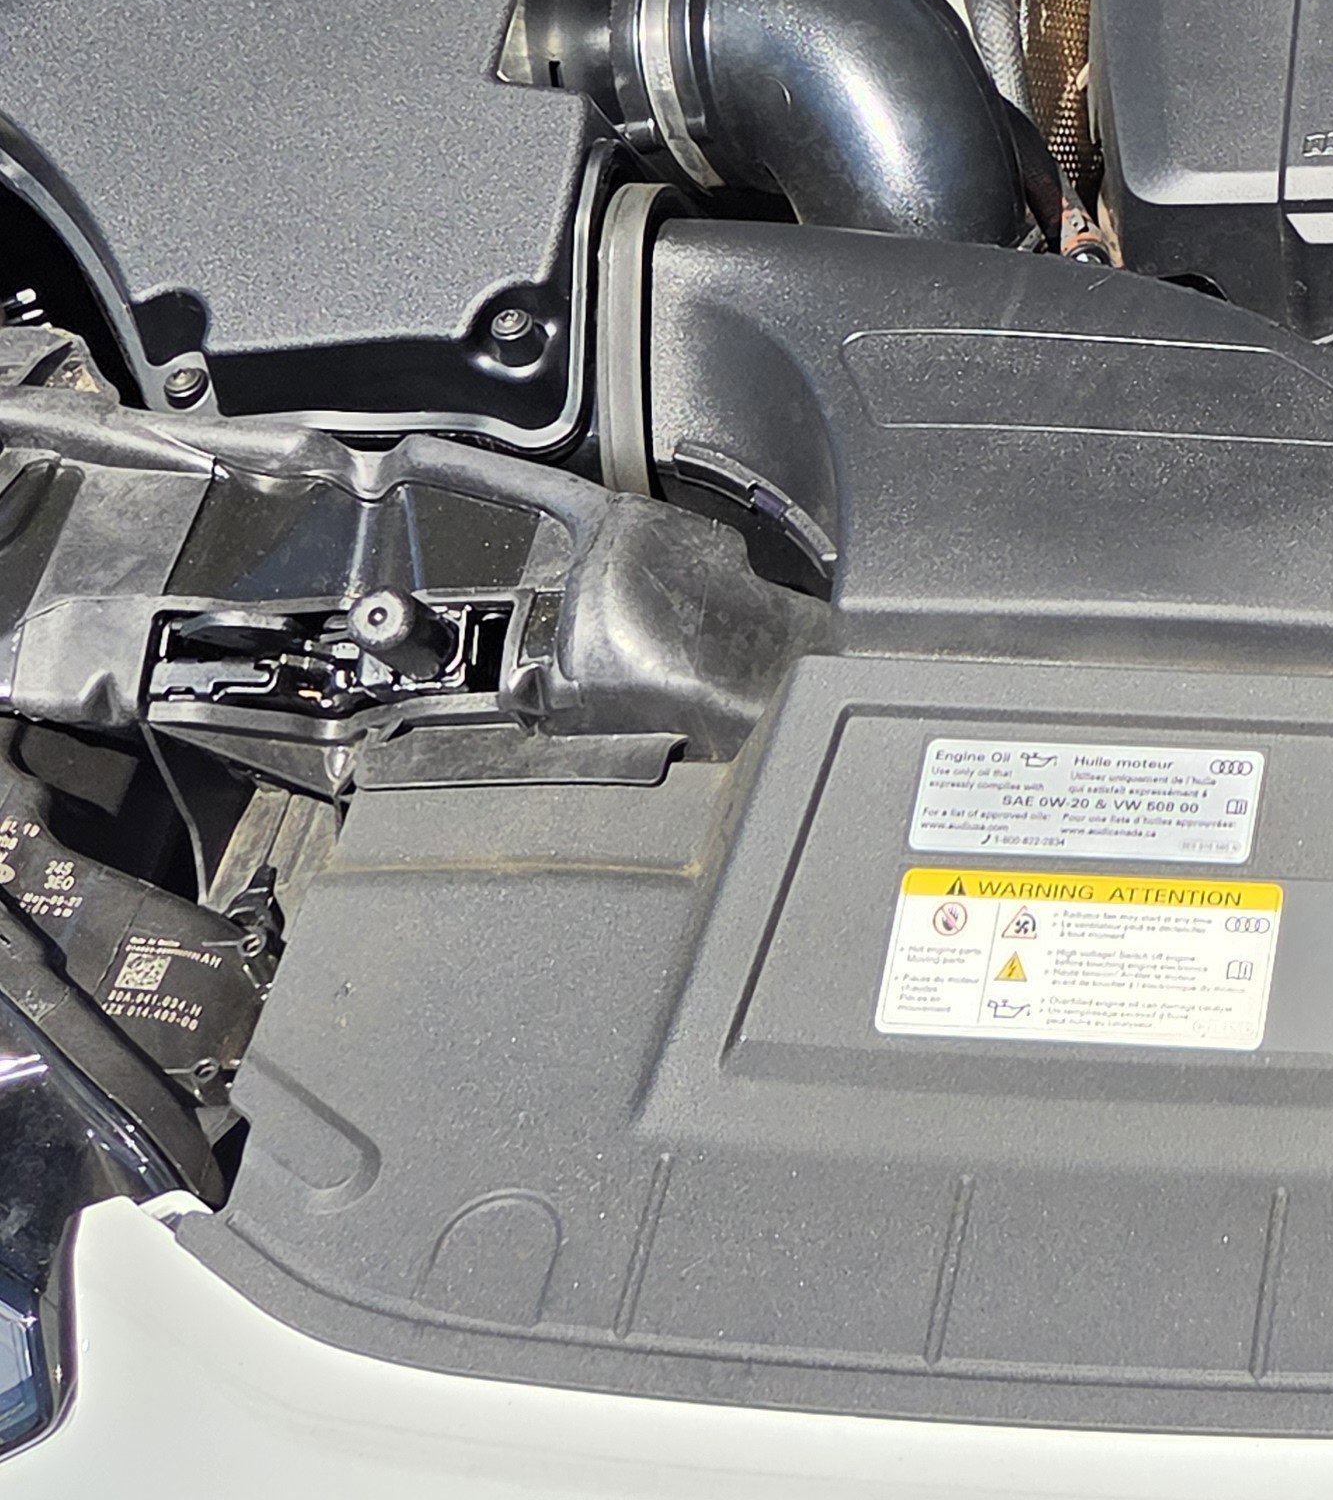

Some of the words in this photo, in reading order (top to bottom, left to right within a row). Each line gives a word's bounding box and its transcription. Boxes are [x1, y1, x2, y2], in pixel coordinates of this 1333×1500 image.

[936, 750, 985, 763] Engine
[991, 752, 1011, 763] Oil
[1074, 755, 1112, 768] Huile
[1116, 757, 1174, 770] moteur
[1002, 796, 1034, 807] SAE
[1114, 800, 1142, 811] VW
[978, 881, 1094, 900] WARNING
[1109, 886, 1242, 907] ATTENTION
